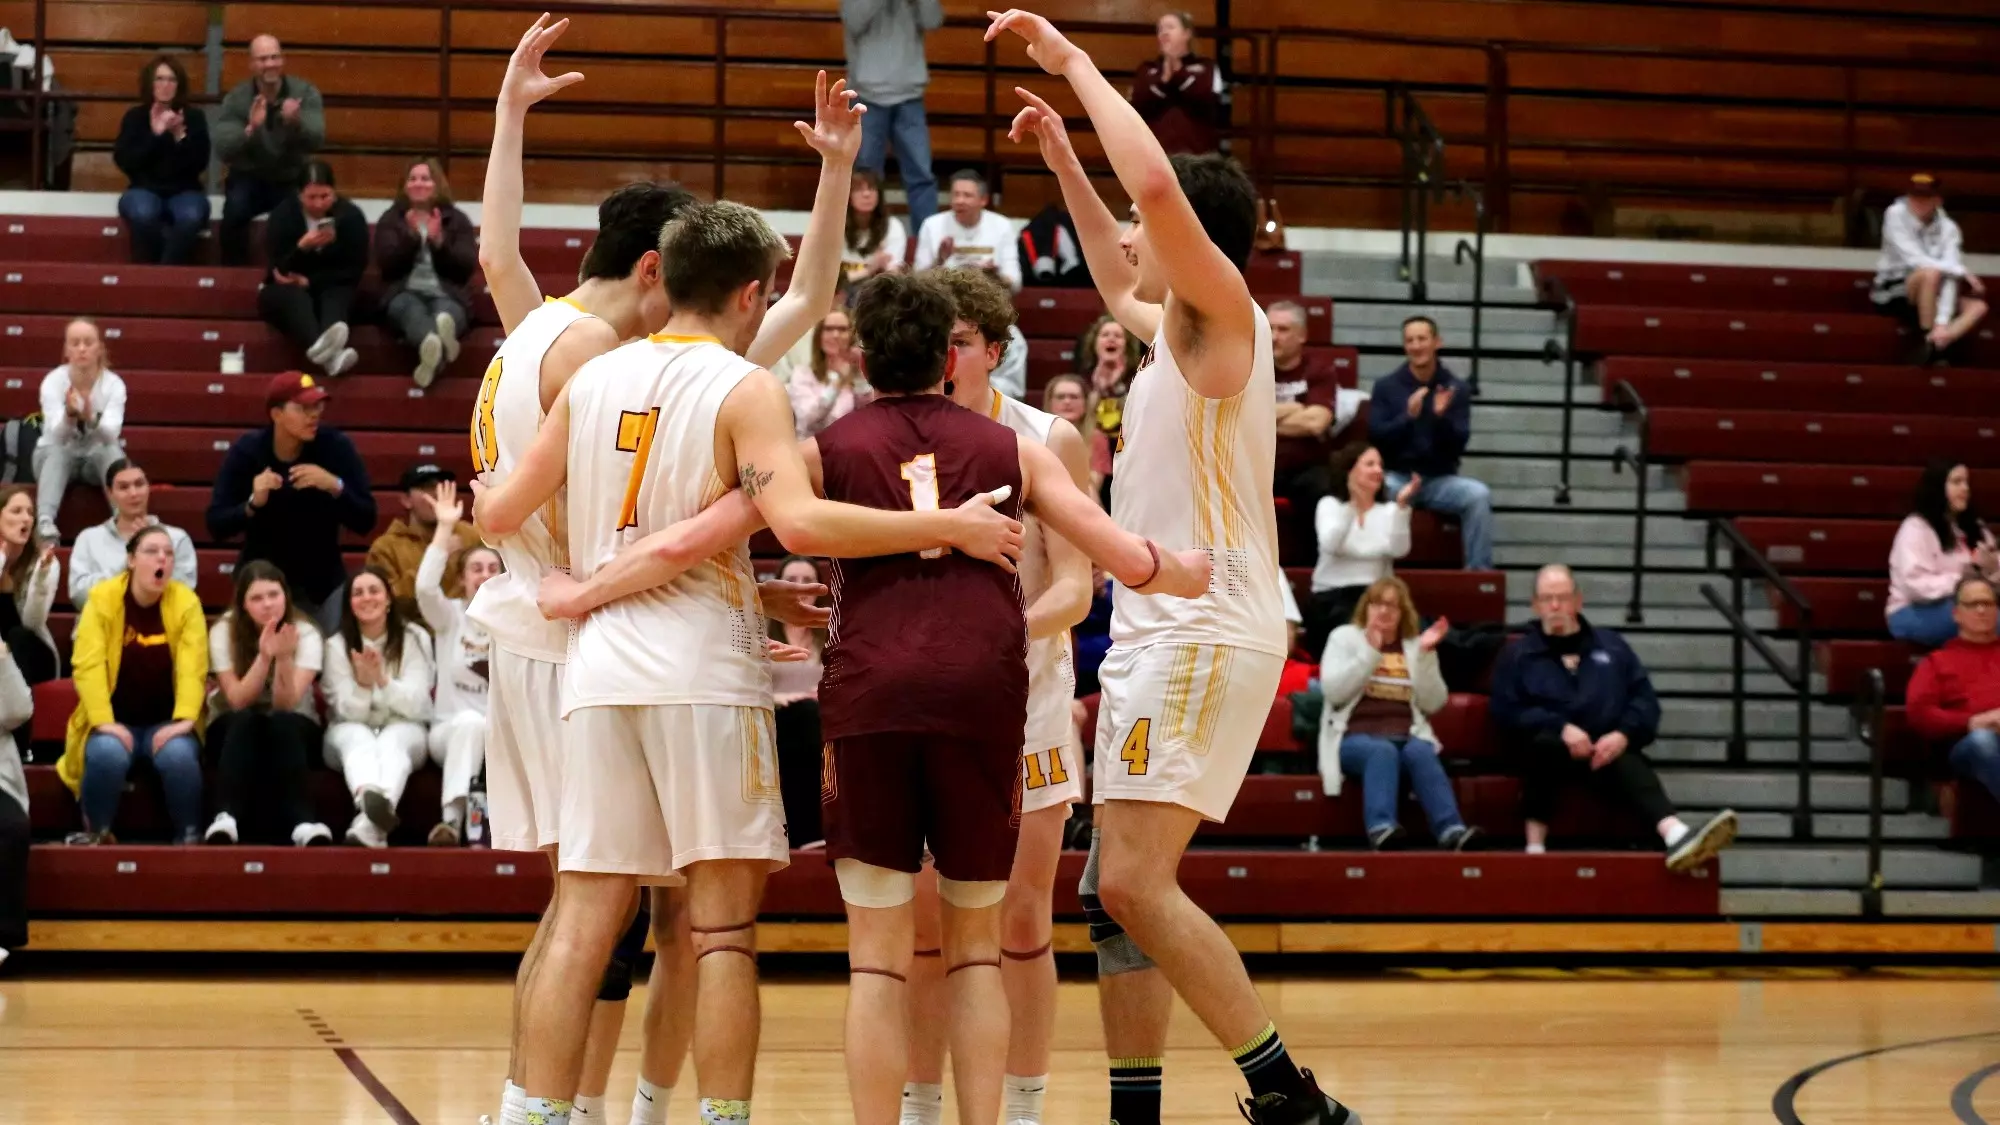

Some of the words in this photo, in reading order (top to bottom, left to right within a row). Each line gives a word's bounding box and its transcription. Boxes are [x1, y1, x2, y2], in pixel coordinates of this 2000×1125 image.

[615, 406, 661, 532] 7
[900, 452, 952, 560] 1
[1024, 747, 1069, 790] 11
[1120, 717, 1151, 775] 4
